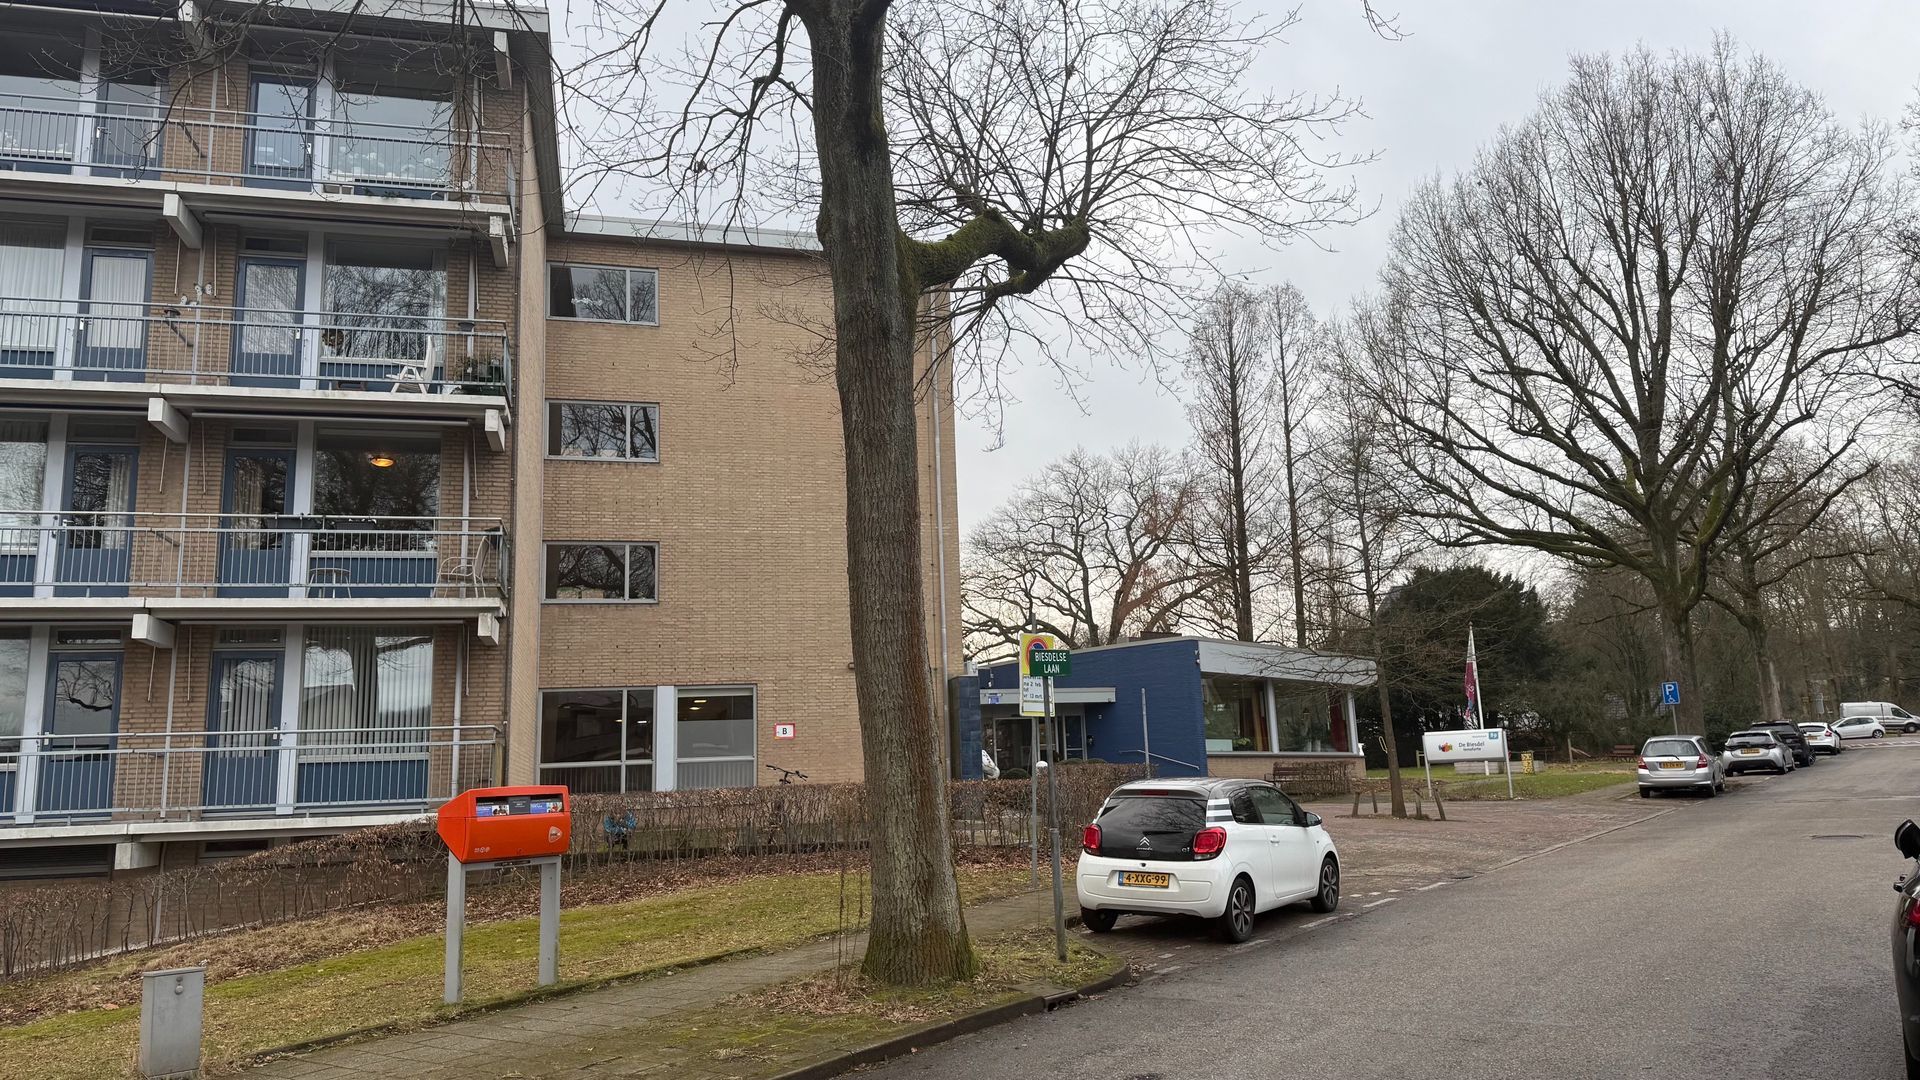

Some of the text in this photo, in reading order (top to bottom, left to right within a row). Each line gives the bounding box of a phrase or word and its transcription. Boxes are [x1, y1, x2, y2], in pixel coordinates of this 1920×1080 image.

[1035, 652, 1066, 662] BIESDELSE
[1043, 664, 1060, 674] LAAN
[1665, 684, 1675, 695] P
[782, 727, 788, 735] B
[1125, 873, 1167, 885] 4-XXG-99
